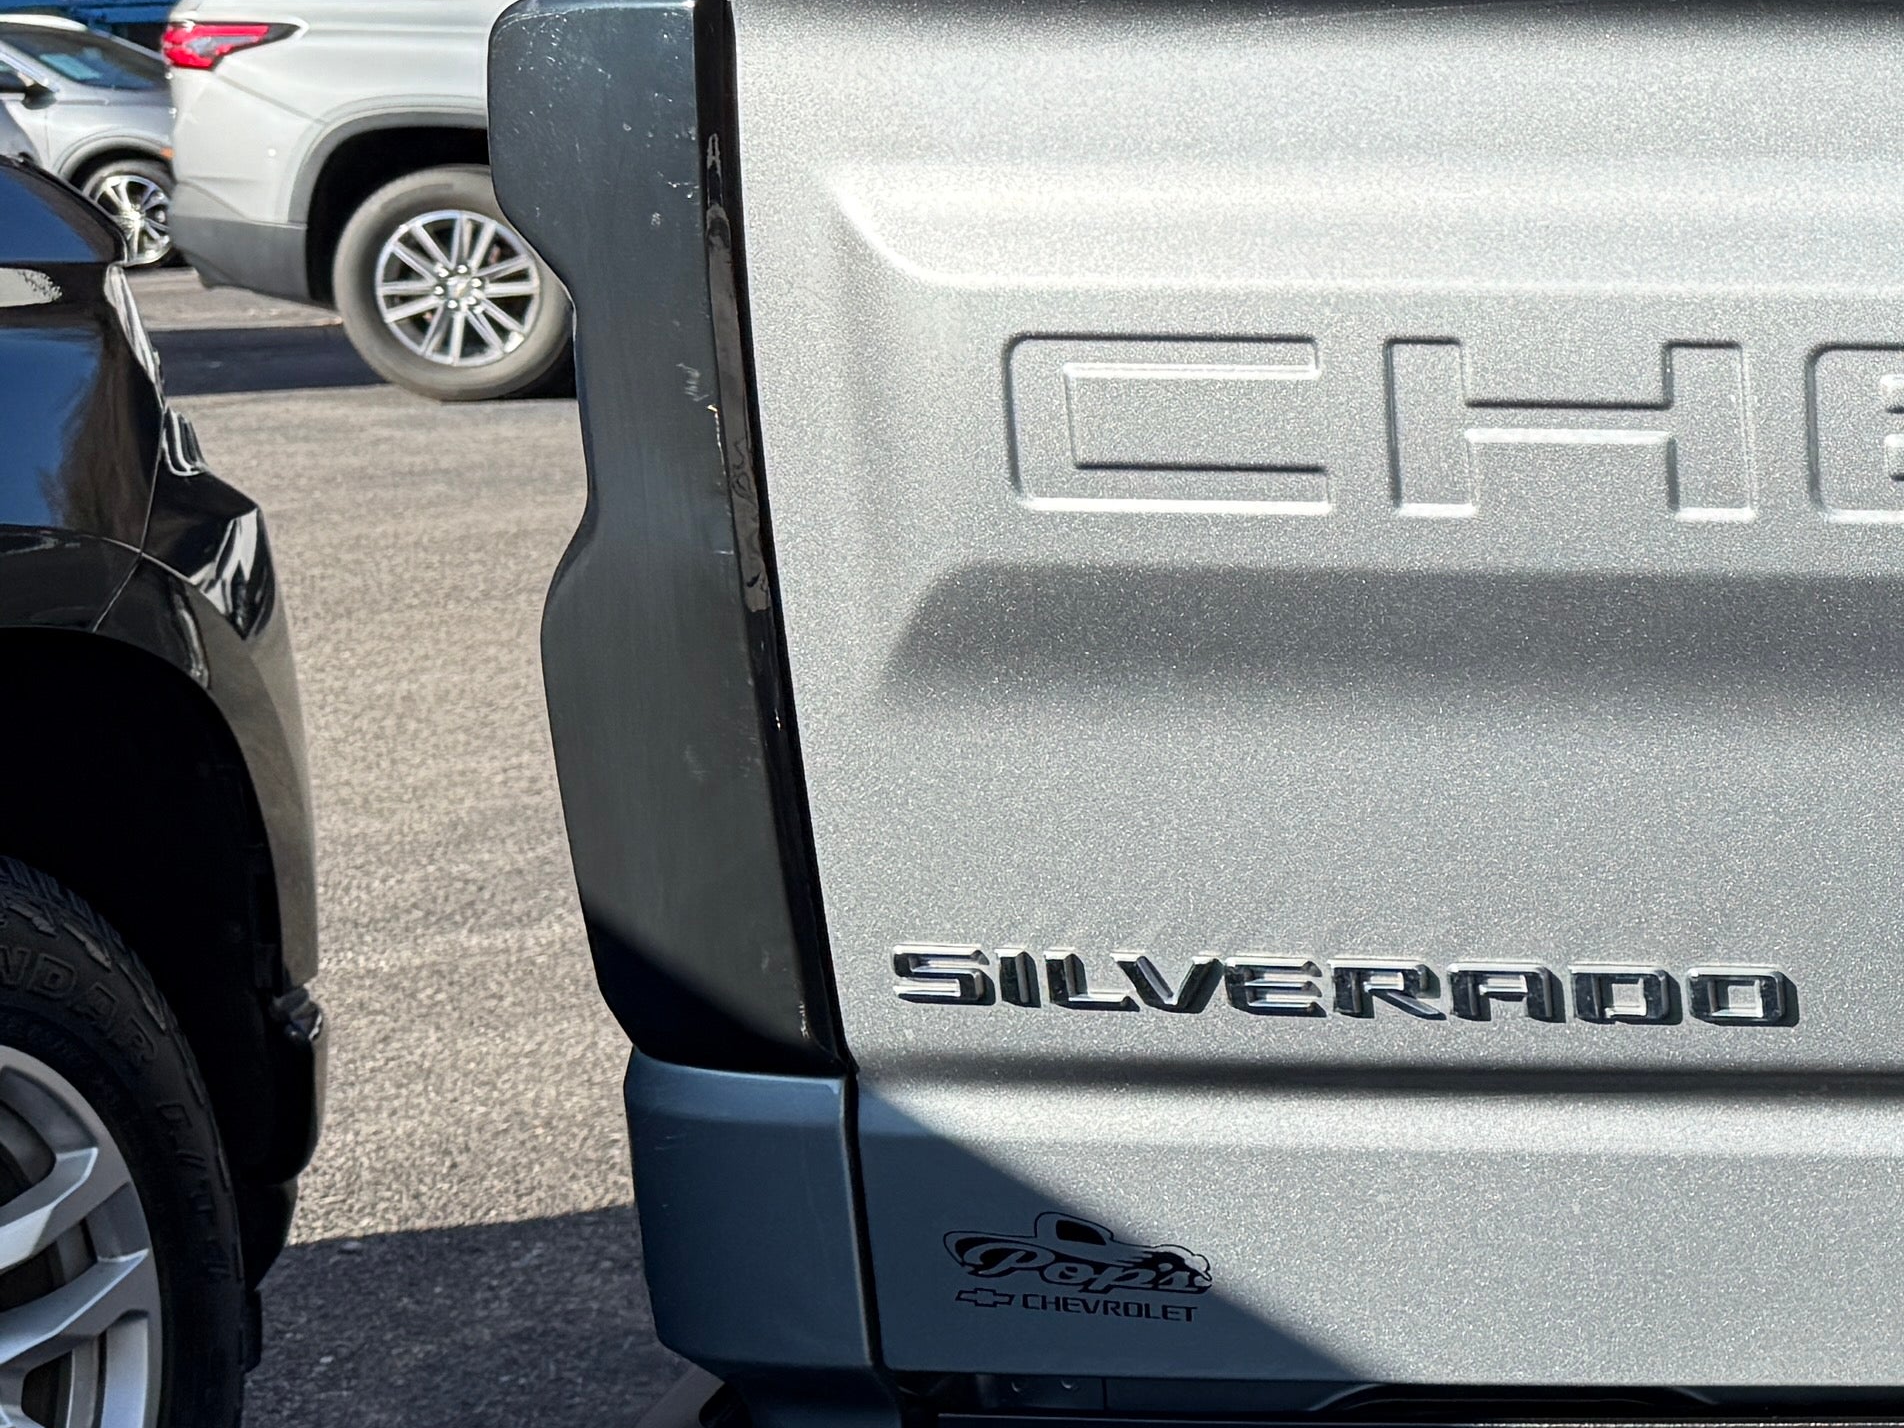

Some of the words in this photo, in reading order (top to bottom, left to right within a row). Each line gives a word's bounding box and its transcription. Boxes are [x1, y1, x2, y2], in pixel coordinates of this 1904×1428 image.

[891, 942, 1798, 1028] SILVERADO
[962, 1241, 1197, 1294] Pop's
[1021, 1293, 1198, 1322] CHEVROLET
